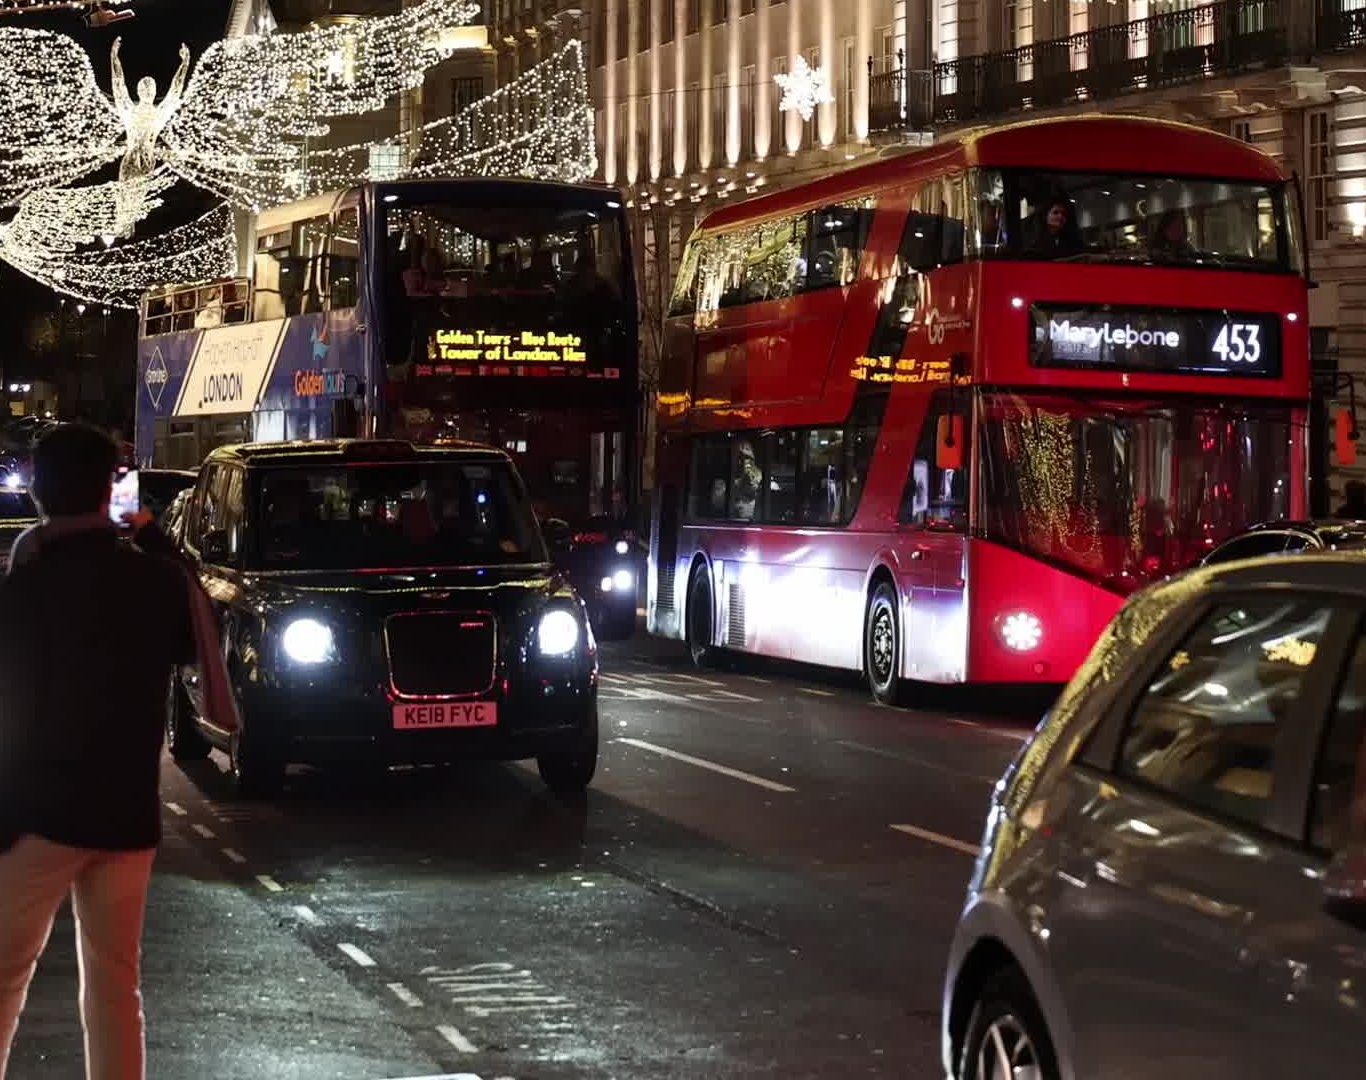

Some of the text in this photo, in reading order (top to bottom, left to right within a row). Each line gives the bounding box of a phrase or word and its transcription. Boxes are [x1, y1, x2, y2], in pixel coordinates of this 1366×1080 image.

[436, 330, 474, 344] Golden
[476, 330, 511, 345] Tours
[521, 332, 545, 345] Blue
[547, 332, 581, 346] Route
[1050, 320, 1261, 363] Marylebone 453
[440, 345, 483, 360] Tower
[485, 346, 501, 360] of
[203, 373, 243, 403] LONDON
[450, 705, 484, 724] FYC
